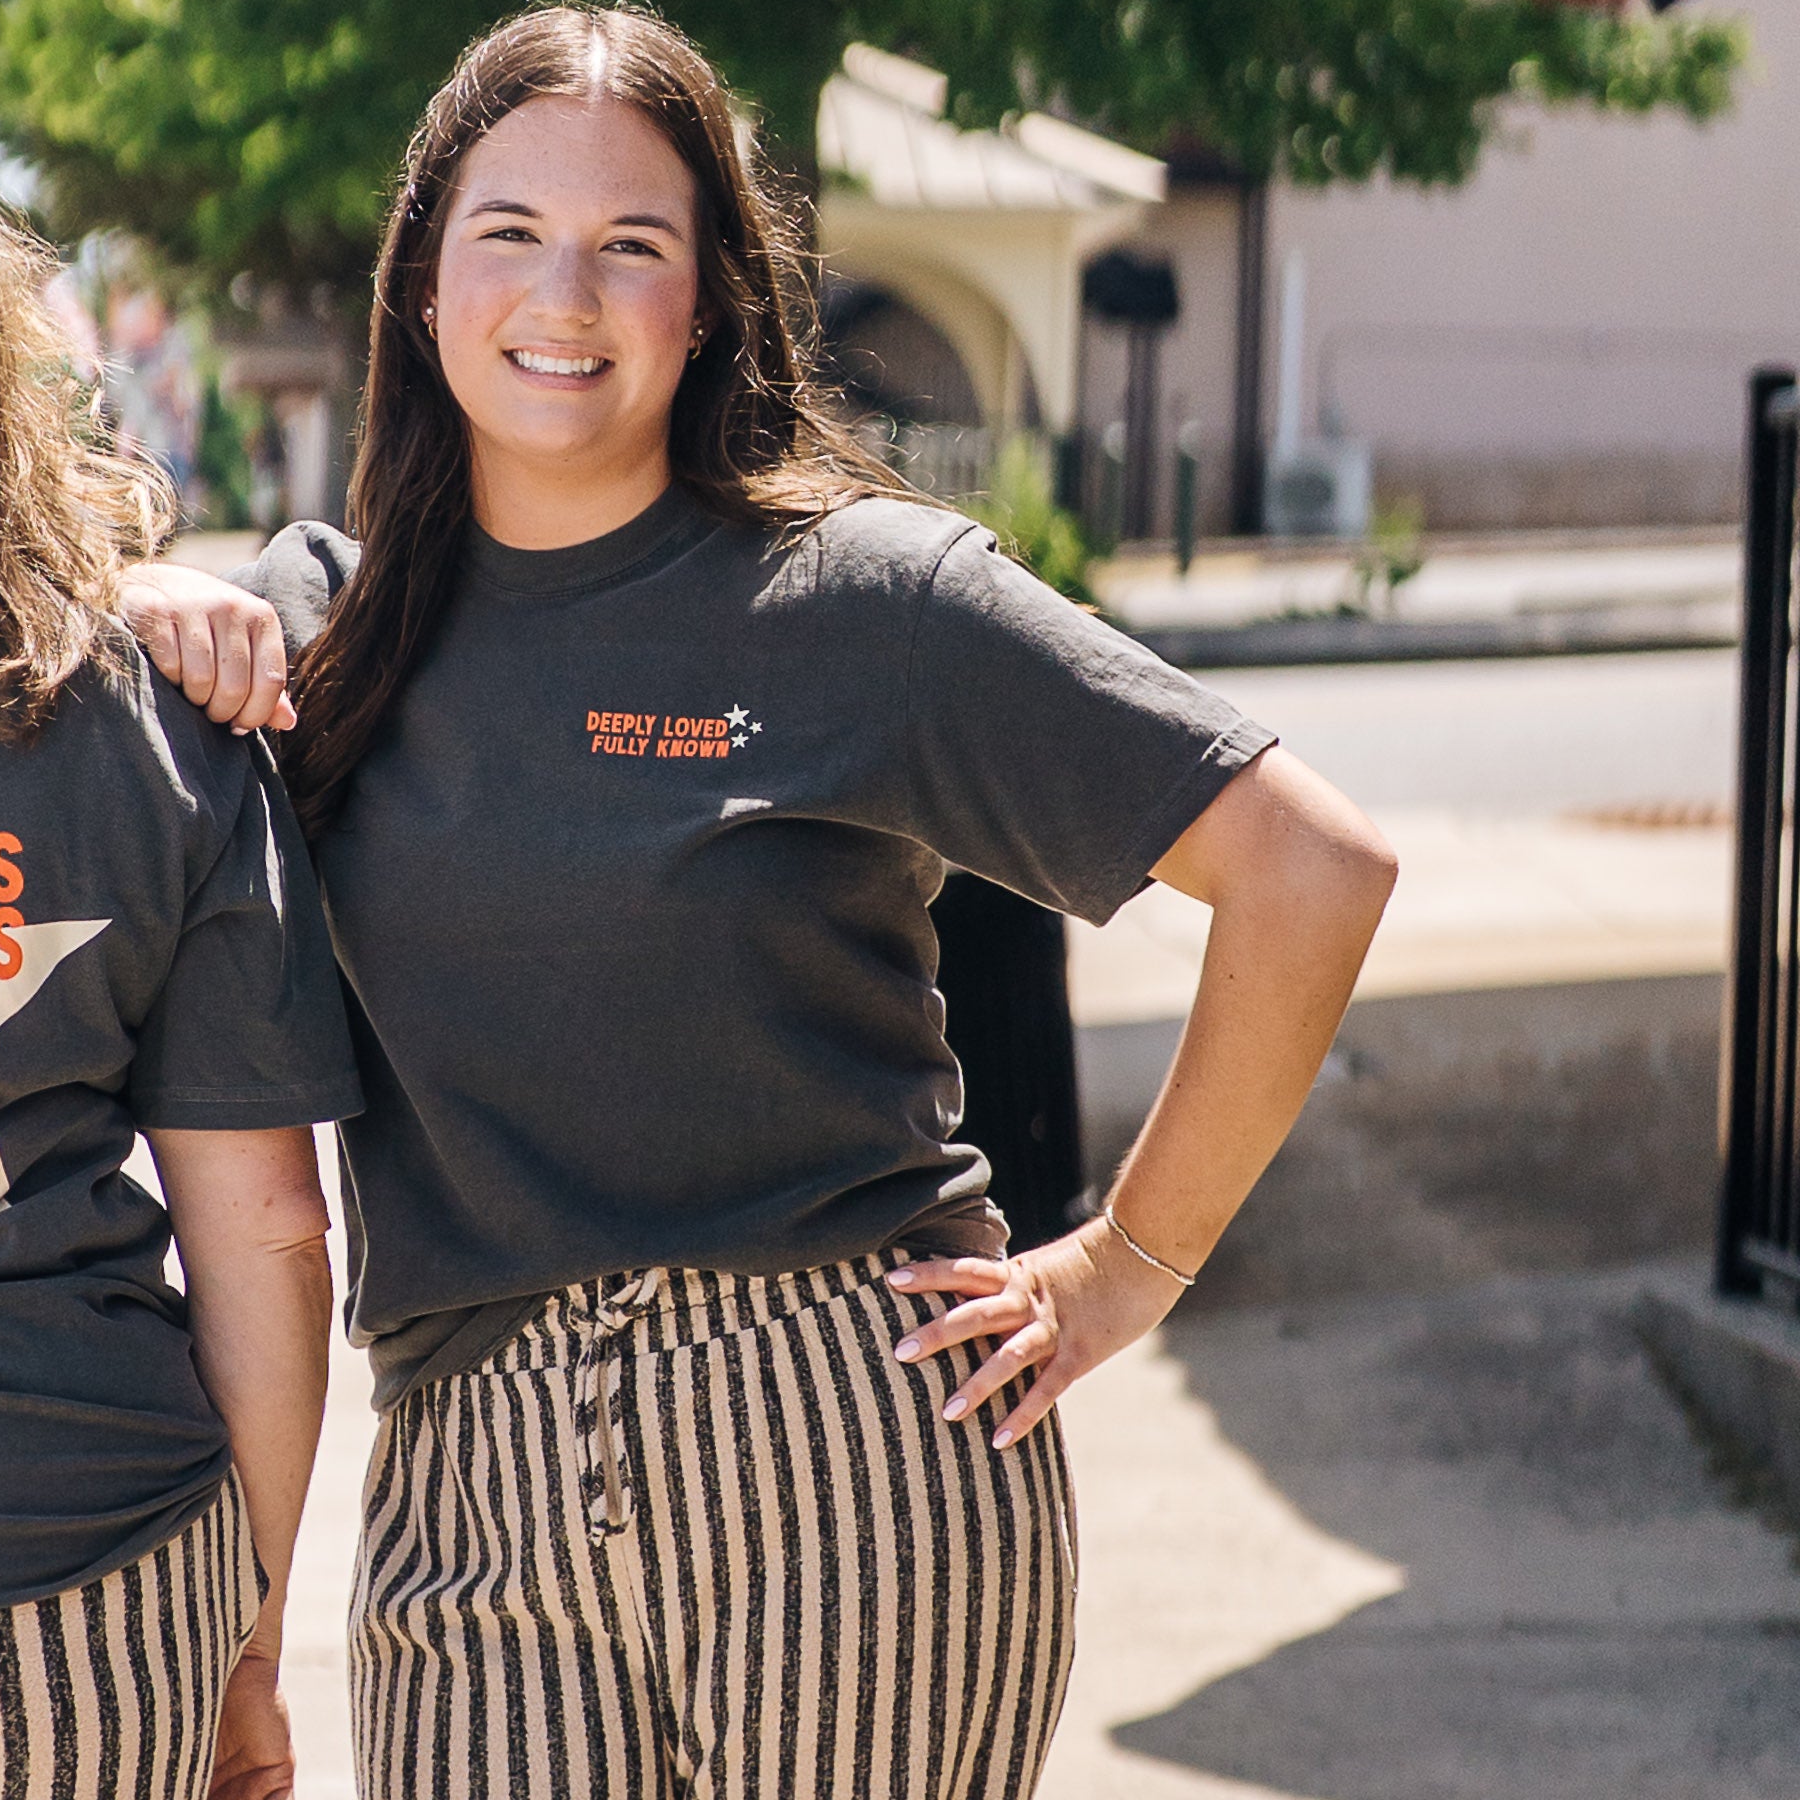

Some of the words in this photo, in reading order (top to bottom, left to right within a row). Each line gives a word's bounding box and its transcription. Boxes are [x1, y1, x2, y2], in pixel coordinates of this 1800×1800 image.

[586, 710, 657, 736] DEEPLY
[663, 716, 728, 738] LOVED
[591, 735, 649, 756] FULLY
[656, 738, 730, 758] KNOWN
